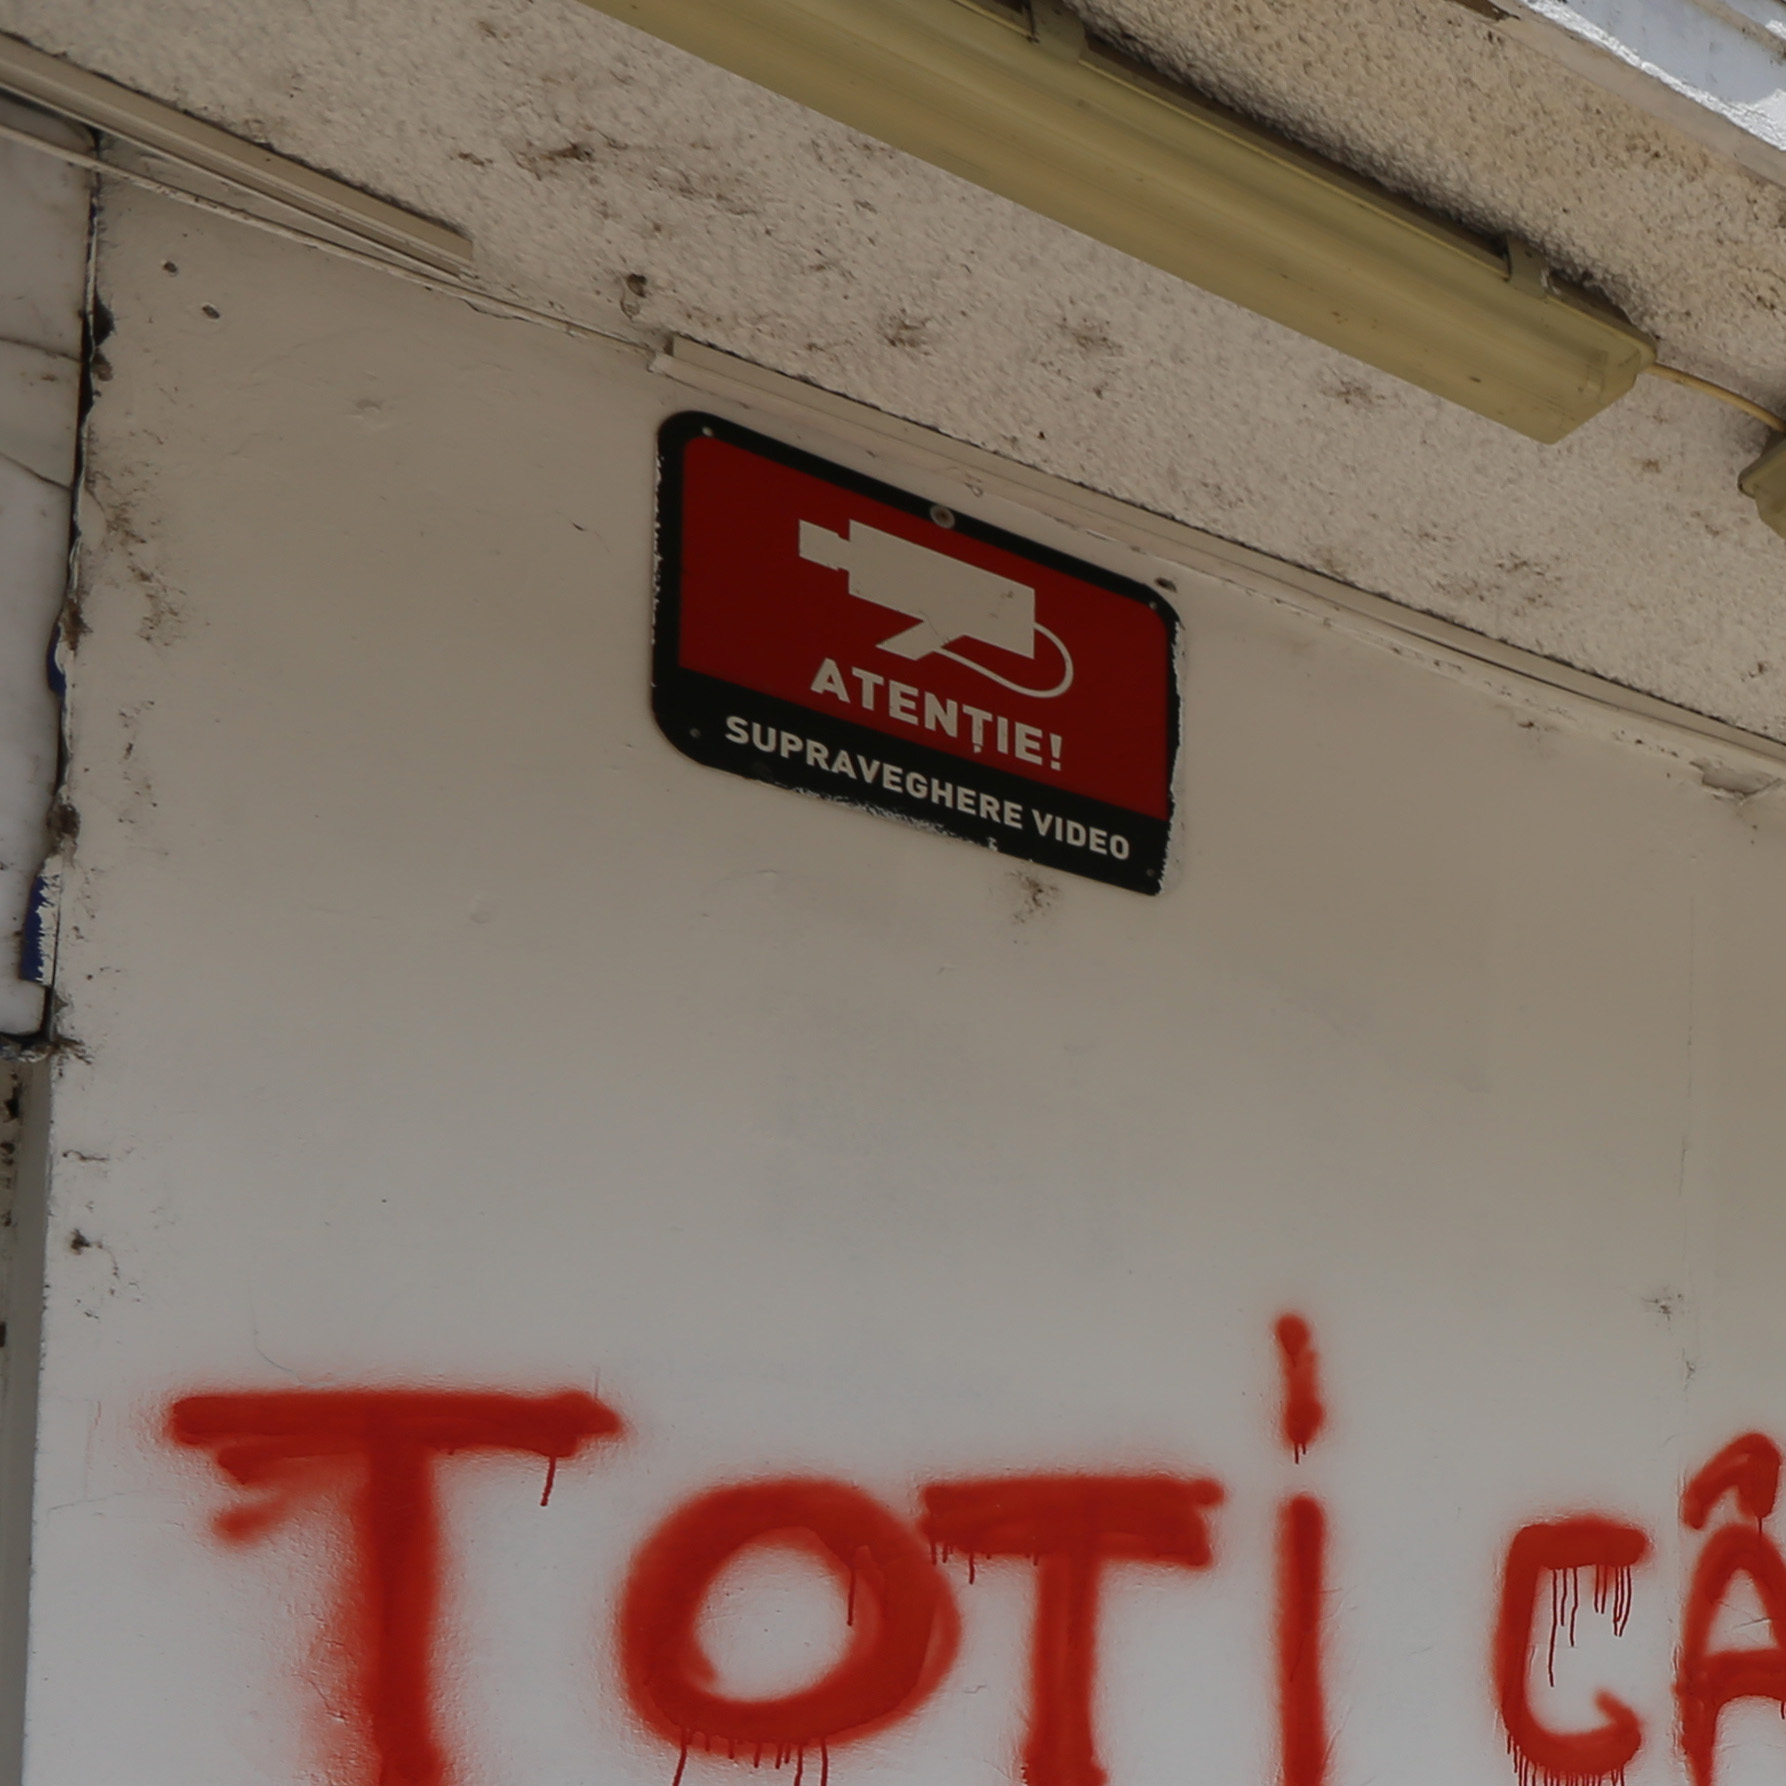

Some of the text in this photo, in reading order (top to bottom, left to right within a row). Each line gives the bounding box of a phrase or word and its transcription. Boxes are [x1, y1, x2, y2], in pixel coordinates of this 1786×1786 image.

[811, 657, 1062, 771] ATENȚIE!
[725, 715, 1130, 860] SUPRAVEGHERE VIDEO
